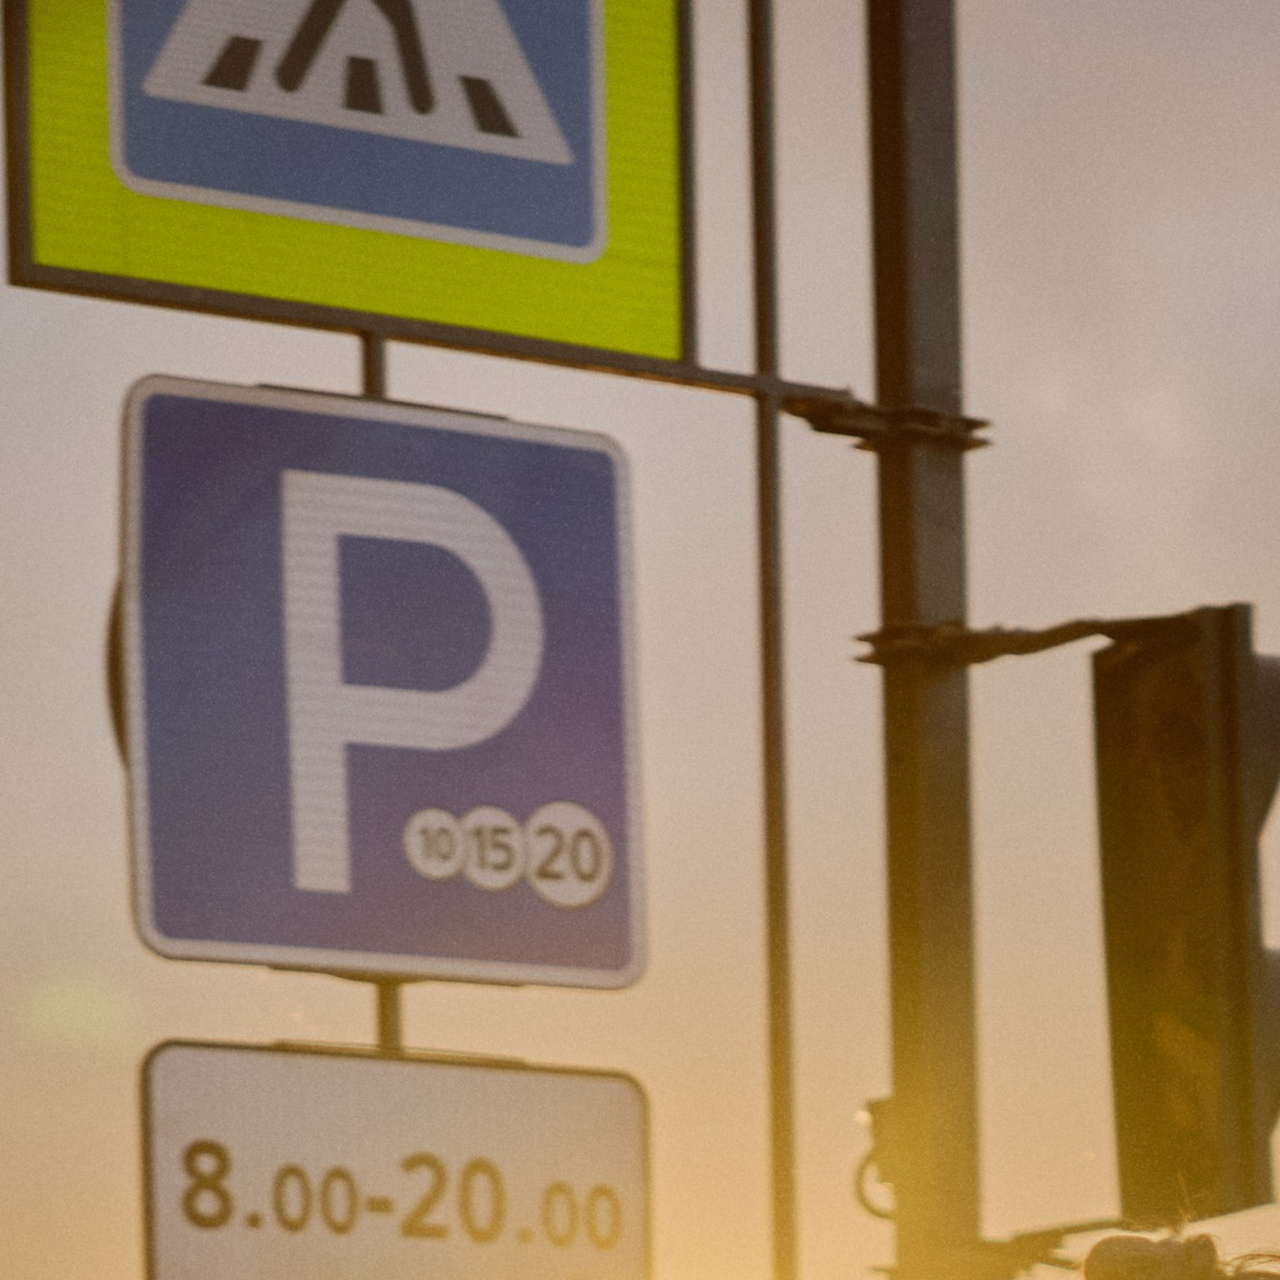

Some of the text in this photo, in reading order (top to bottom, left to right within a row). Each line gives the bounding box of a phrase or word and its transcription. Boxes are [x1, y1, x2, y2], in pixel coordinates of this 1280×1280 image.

[280, 468, 544, 893] P
[418, 824, 601, 883] 10 15 20
[180, 1139, 623, 1250] 8.00-20.00
